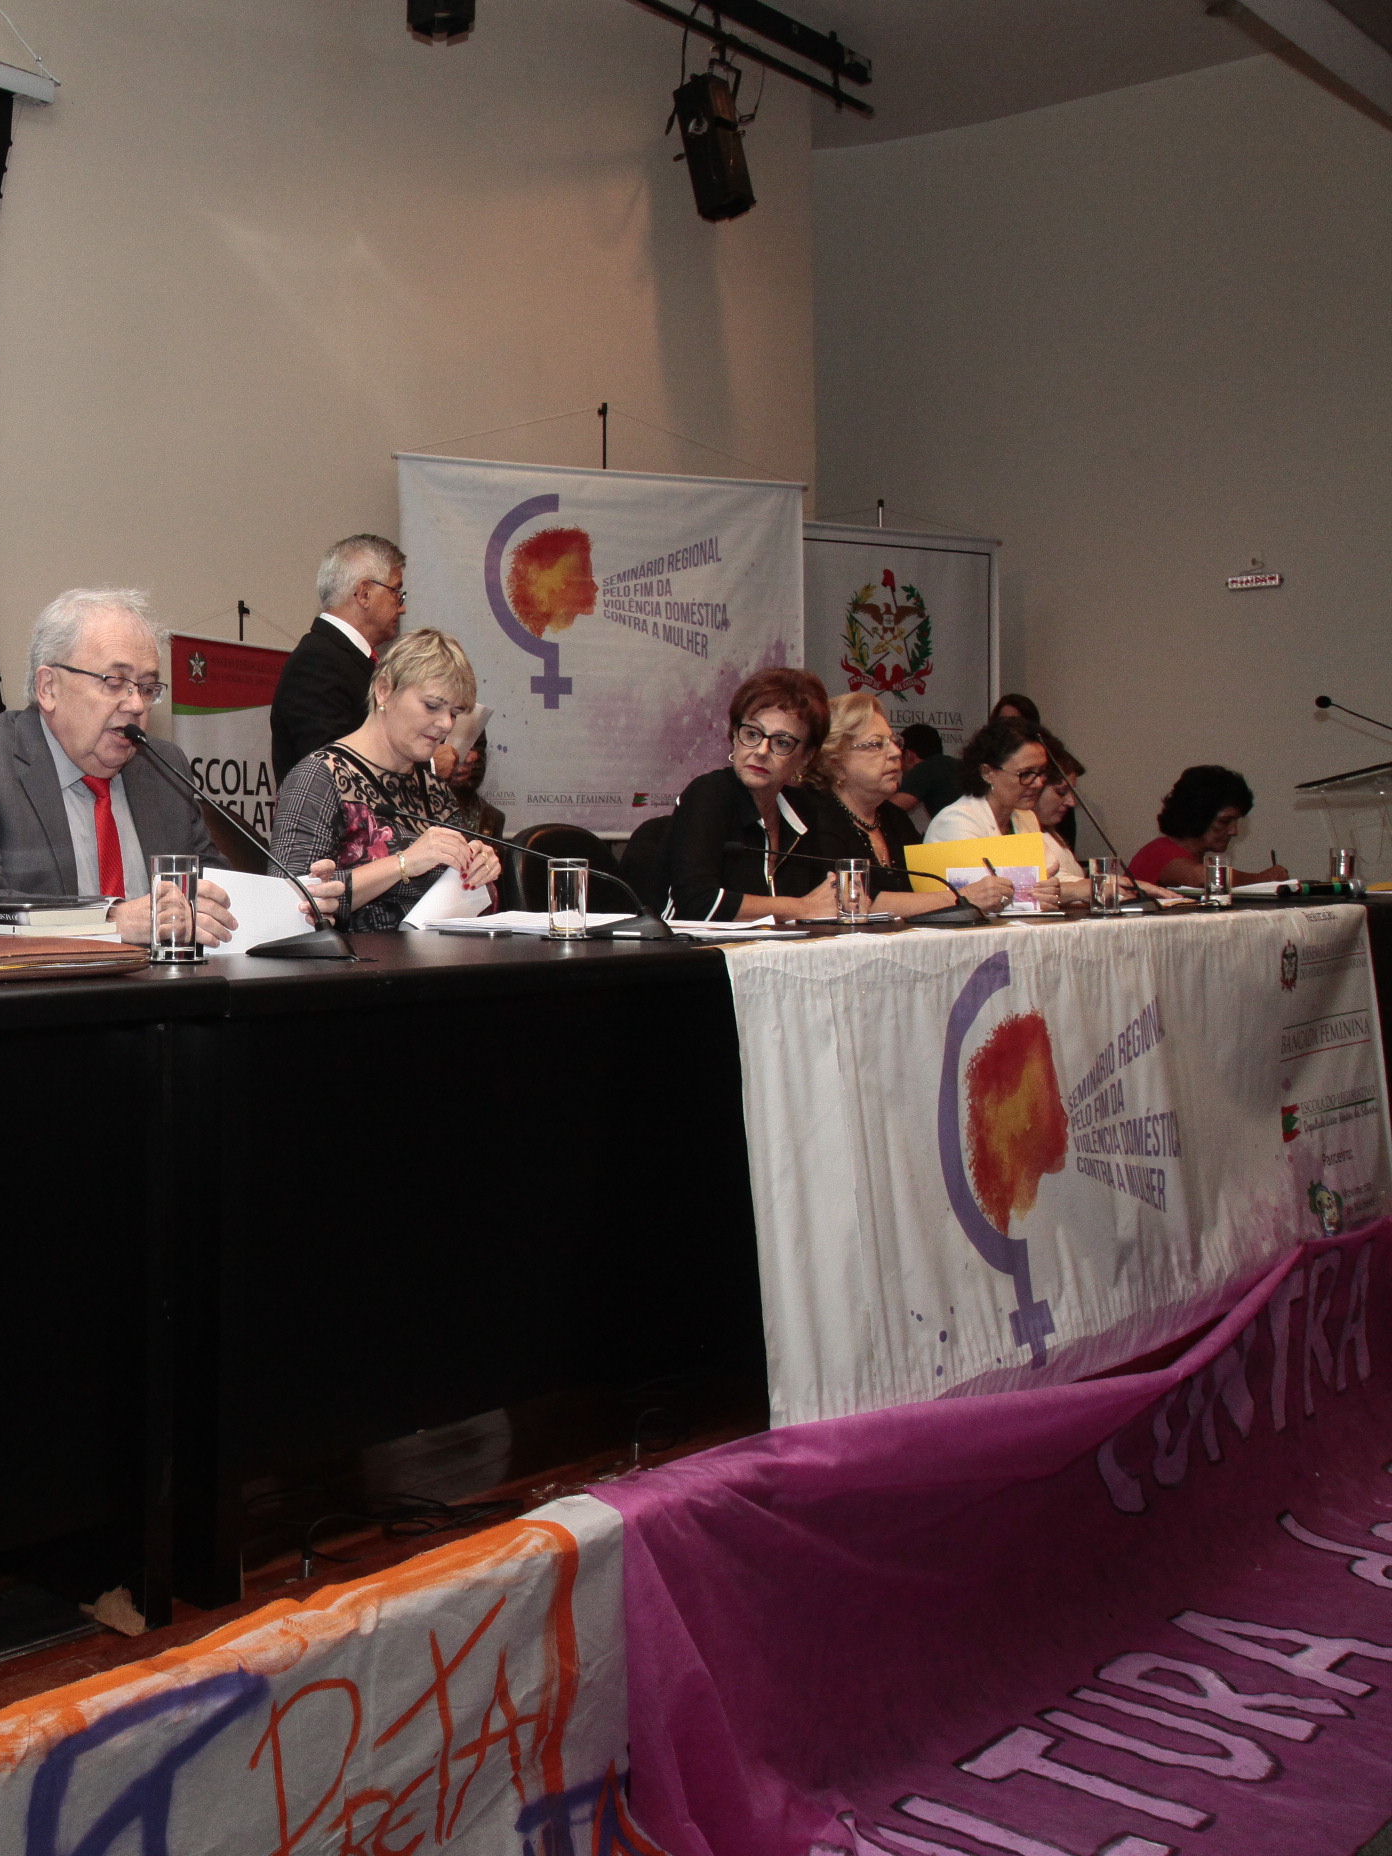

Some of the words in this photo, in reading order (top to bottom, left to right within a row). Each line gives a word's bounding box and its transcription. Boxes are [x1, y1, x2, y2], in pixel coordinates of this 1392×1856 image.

[667, 536, 722, 574] REGIONAL
[602, 585, 631, 598] PELO
[633, 581, 654, 598] FIM
[656, 577, 673, 597] DA
[603, 597, 662, 619] VIOLÊNCIA
[664, 598, 728, 632] DOMÉSTICA
[603, 609, 649, 635] CONTRA
[651, 621, 660, 640] A
[662, 623, 708, 660] MULHER
[890, 709, 964, 727] LEGISLATIVA
[190, 756, 273, 797] SCOLA
[527, 794, 573, 805] BANCADA
[576, 794, 623, 805] FEMININA
[1320, 1017, 1372, 1043] FEMININA
[1071, 1103, 1093, 1134] PELO
[1094, 1092, 1110, 1124] FIM
[1110, 1078, 1126, 1116] DA
[1073, 1124, 1121, 1155] VIOLÊNCIA
[1076, 1156, 1117, 1190] CONTRA
[1116, 1162, 1127, 1194] A
[1124, 1162, 1167, 1213] MULHER
